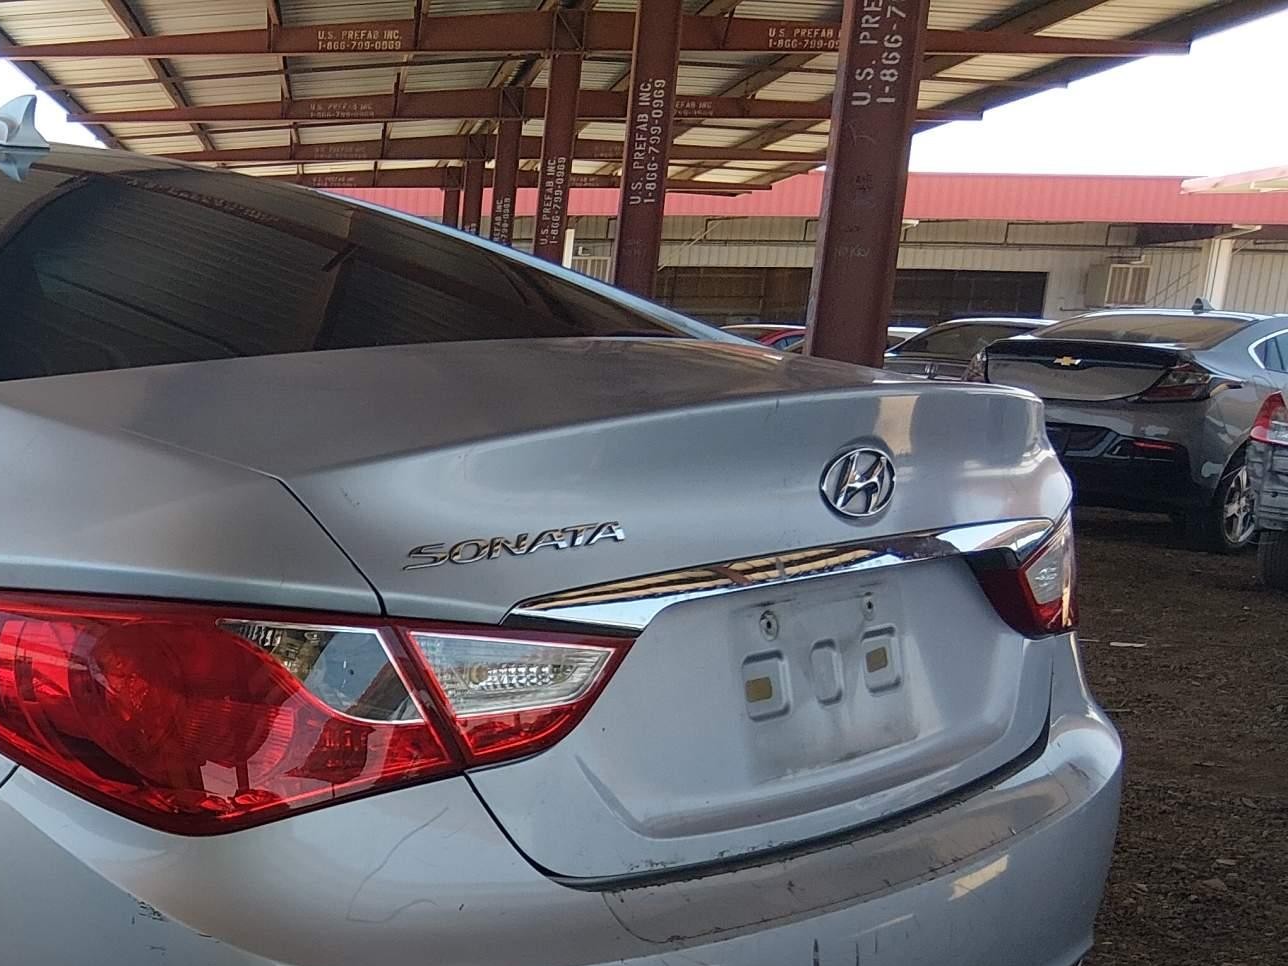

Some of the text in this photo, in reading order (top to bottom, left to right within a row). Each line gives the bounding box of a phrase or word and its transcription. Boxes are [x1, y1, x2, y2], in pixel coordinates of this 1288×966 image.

[317, 29, 403, 40] U.S. PREFAB INC.
[793, 28, 834, 38] PREFAB
[851, 60, 876, 105] U.S.
[629, 78, 653, 205] U.S. PREFAB INC.
[643, 79, 666, 203] 1-866-799-0969
[542, 180, 554, 220] PREFAB
[549, 157, 566, 244] 1-866-799-0969
[539, 225, 550, 245] U.S.
[402, 520, 626, 571] SONATA
